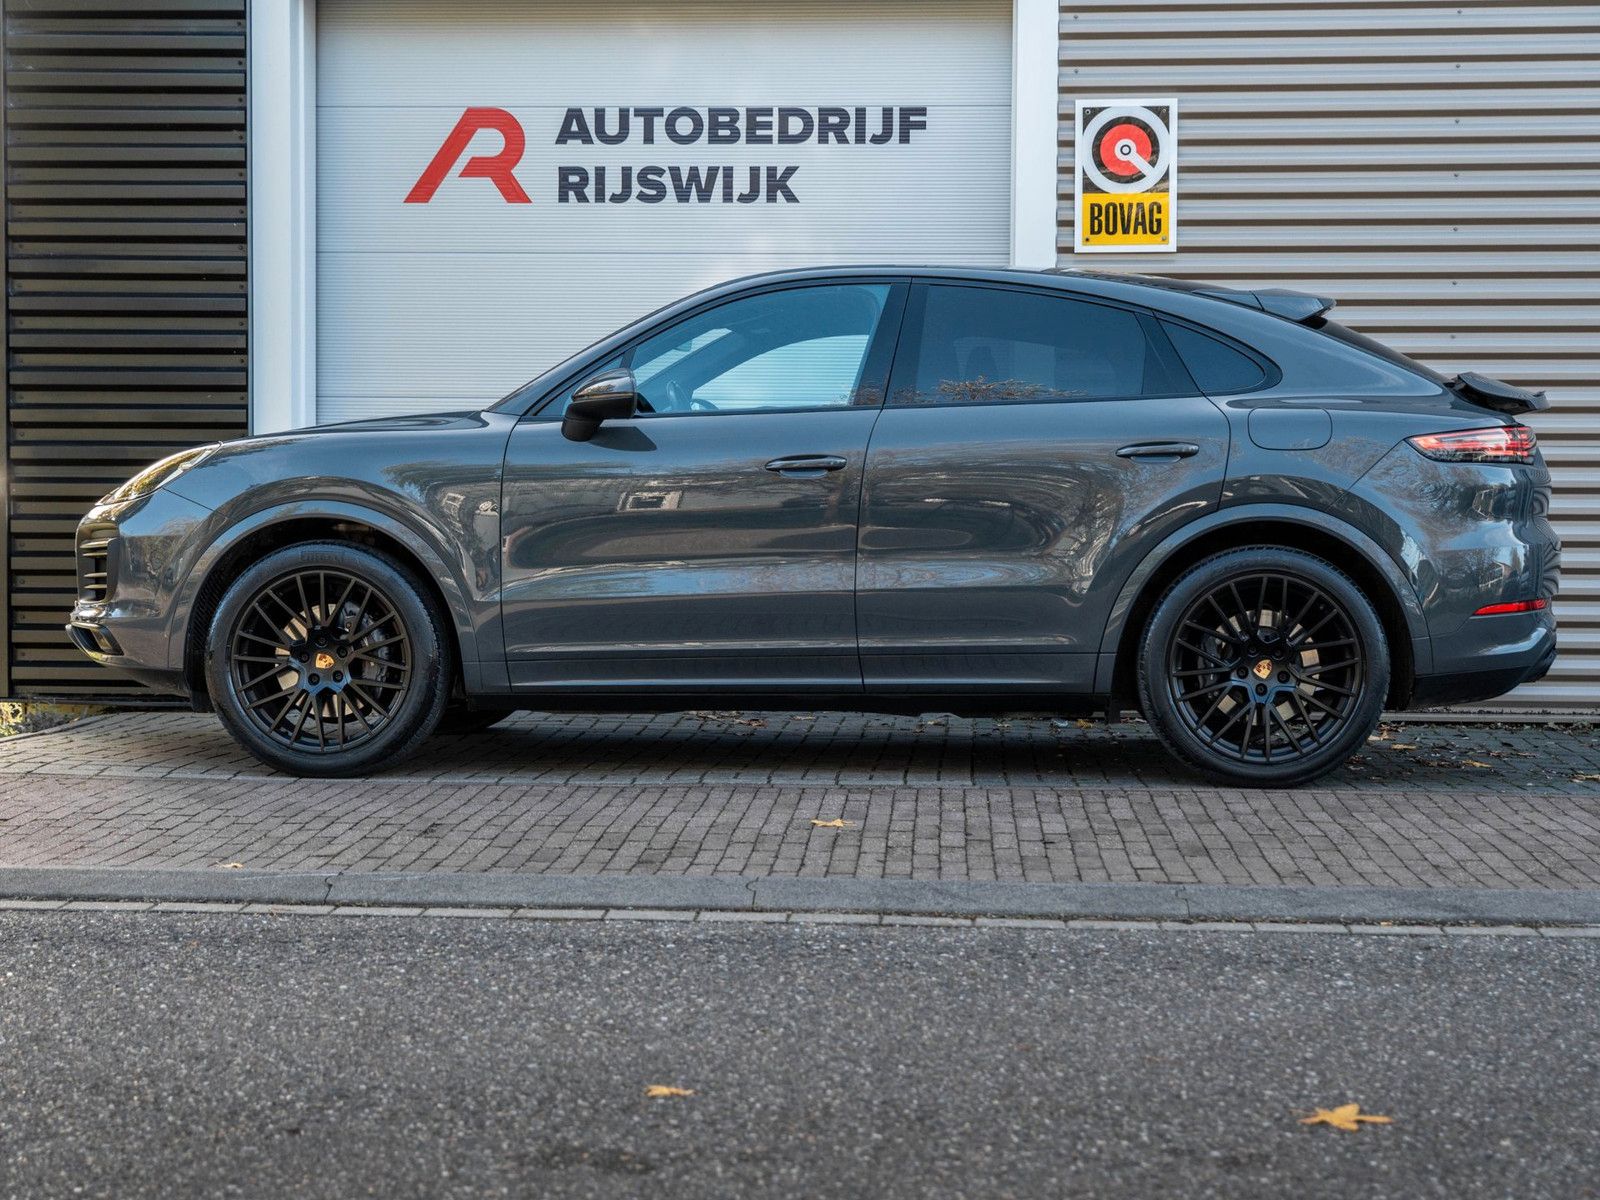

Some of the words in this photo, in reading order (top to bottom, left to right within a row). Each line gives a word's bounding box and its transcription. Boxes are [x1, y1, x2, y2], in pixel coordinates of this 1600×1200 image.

[555, 106, 928, 145] AUTOBEDRIJF
[558, 165, 800, 204] RIJSWIJK
[1089, 201, 1162, 236] BOVAG
